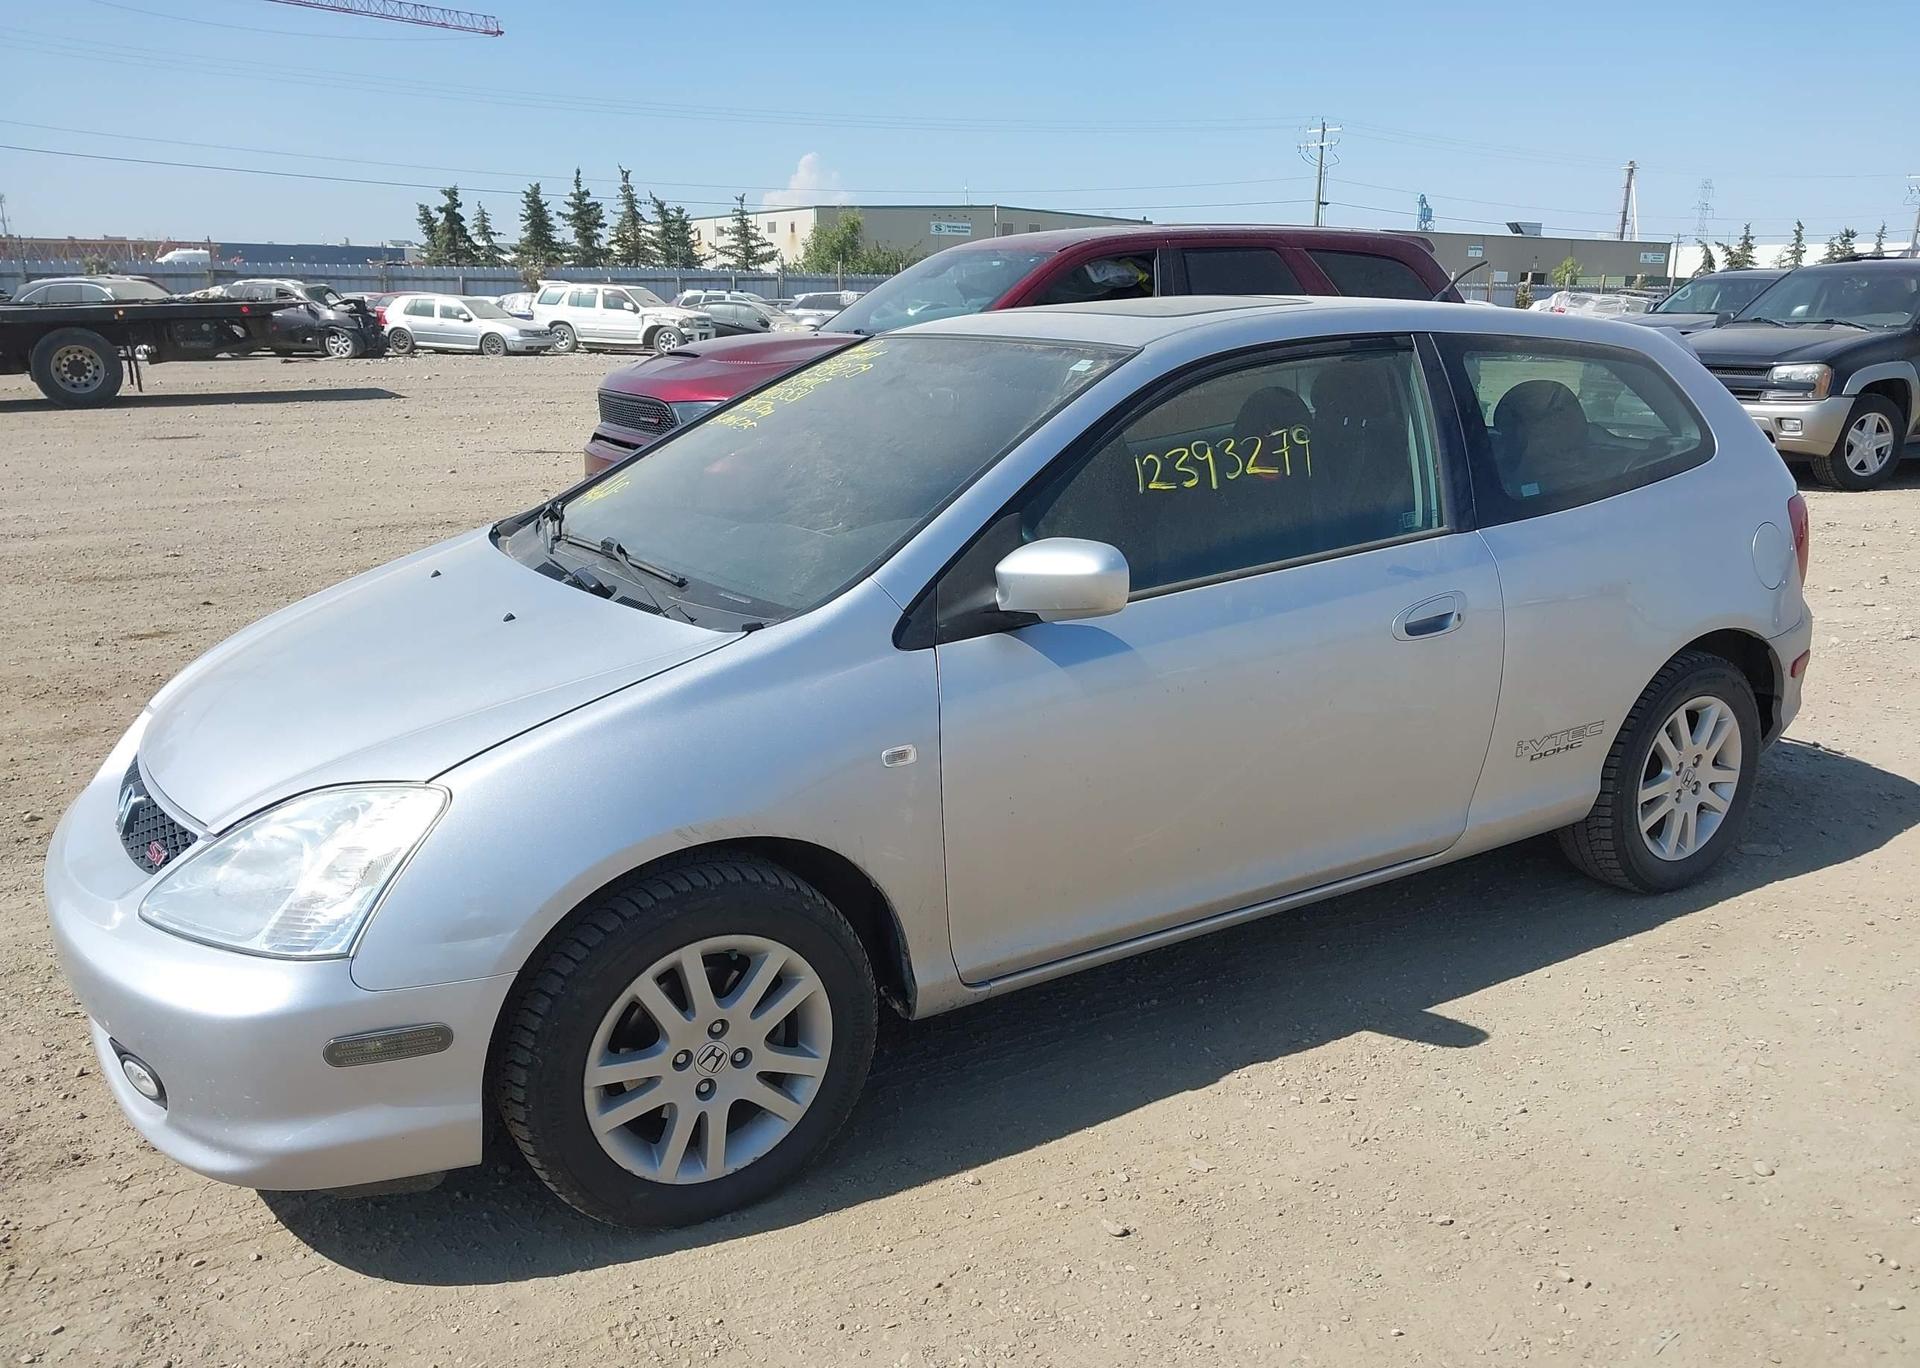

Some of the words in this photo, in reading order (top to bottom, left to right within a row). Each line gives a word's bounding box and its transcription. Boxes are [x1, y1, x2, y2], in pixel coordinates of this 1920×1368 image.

[1134, 425, 1311, 494] 12393279
[1529, 741, 1583, 761] DOHC
[145, 840, 168, 866] Si
